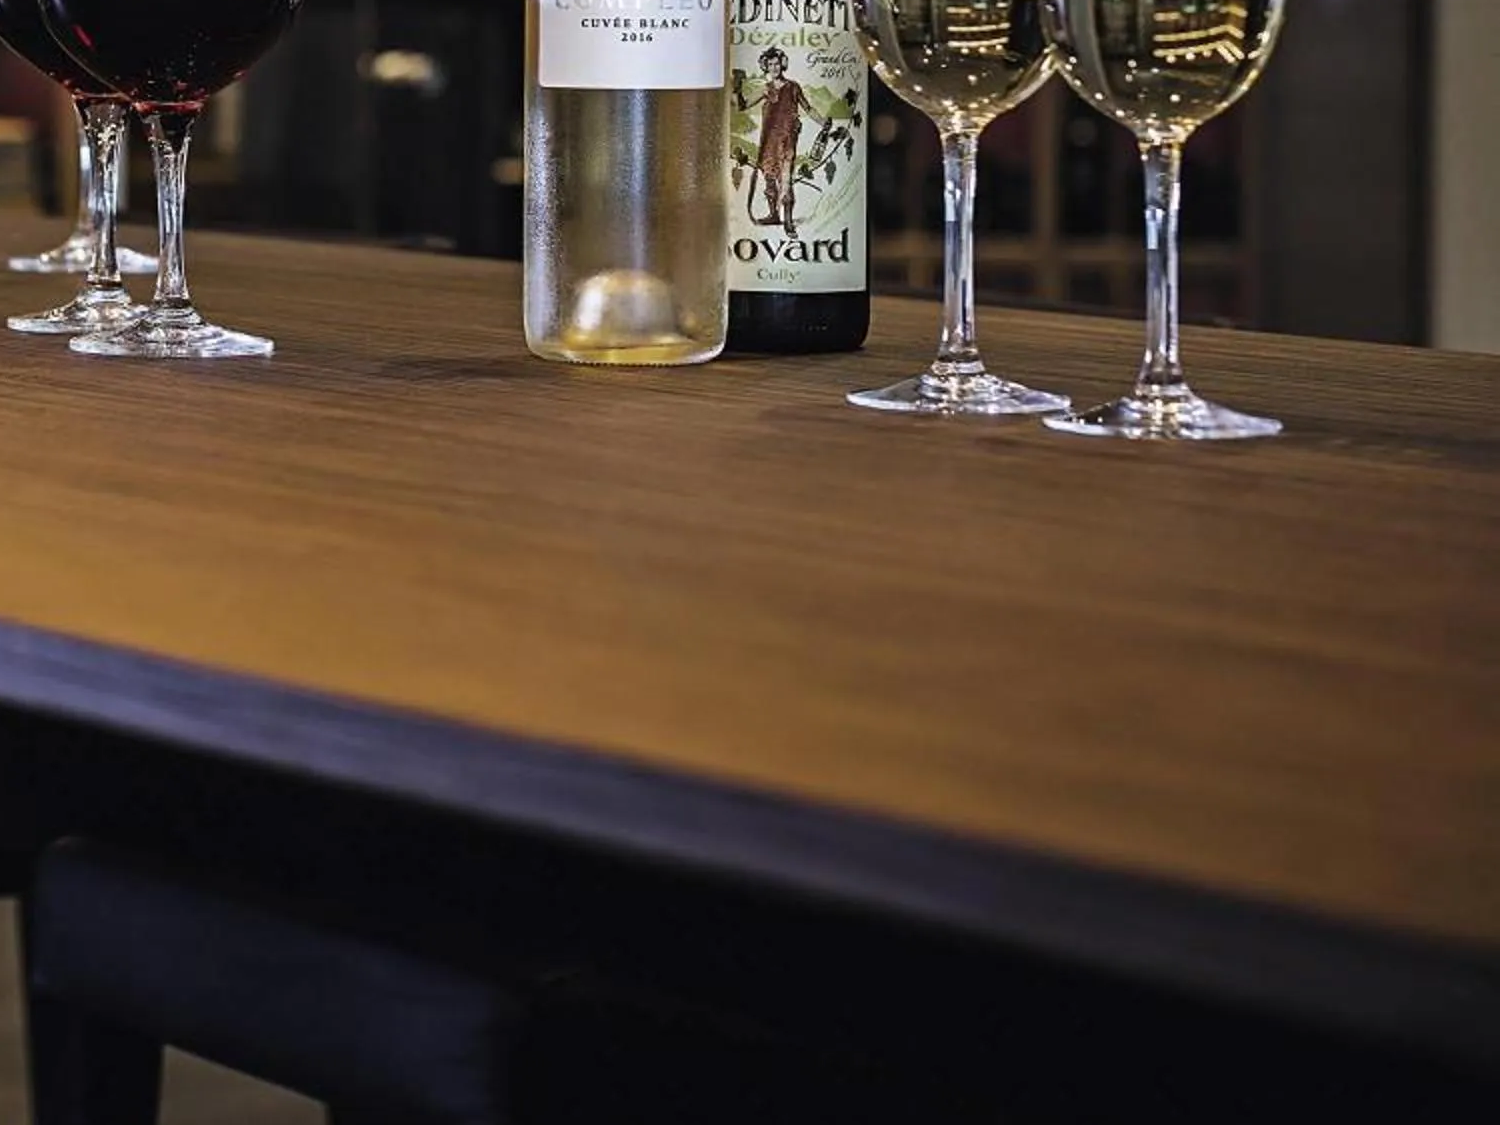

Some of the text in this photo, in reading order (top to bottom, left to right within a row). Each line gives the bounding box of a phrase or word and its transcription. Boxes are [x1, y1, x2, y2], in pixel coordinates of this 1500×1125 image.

[581, 16, 690, 28] CUVÉE BLANC
[621, 32, 653, 42] 2016
[728, 227, 850, 263] ovard
